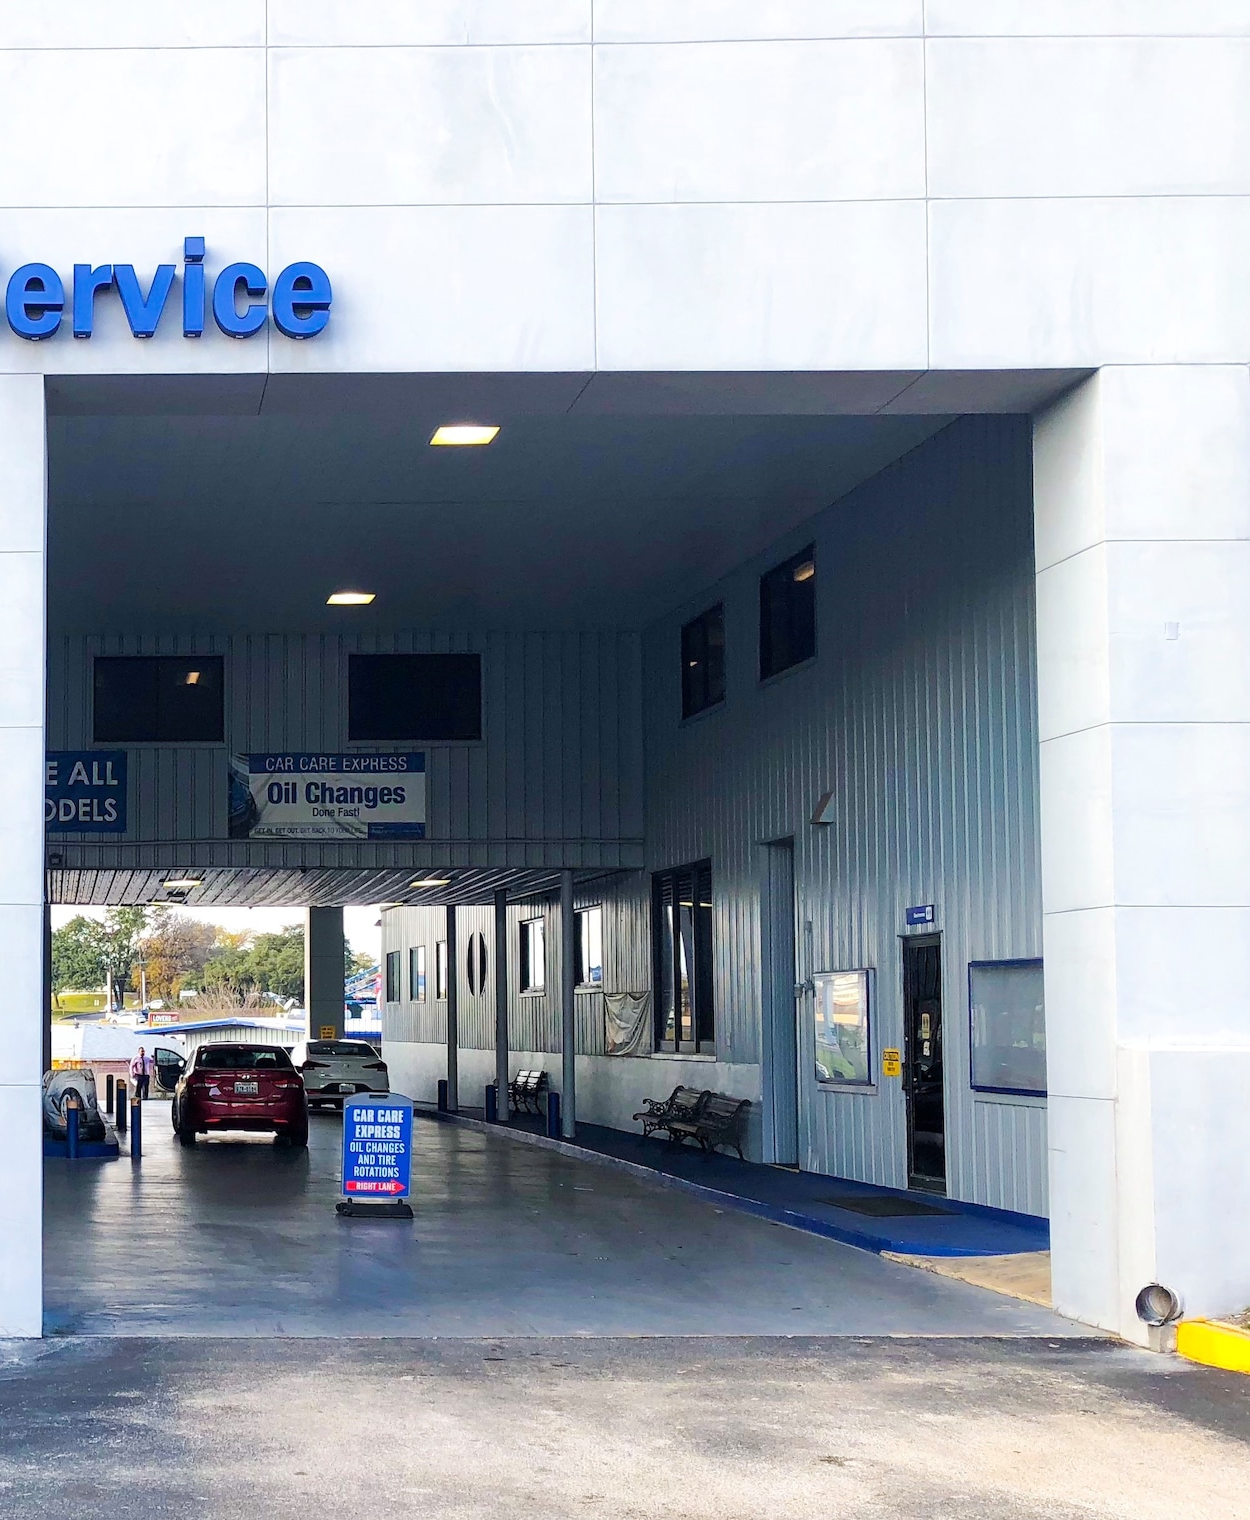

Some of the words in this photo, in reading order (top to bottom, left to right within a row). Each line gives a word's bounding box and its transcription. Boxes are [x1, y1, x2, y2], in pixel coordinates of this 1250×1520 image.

[265, 756, 294, 771] CAR
[300, 757, 337, 771] CARE
[343, 756, 408, 771] EXPRESS
[67, 761, 119, 786] ALL
[267, 781, 297, 805] Oil
[305, 781, 406, 809] Changes
[312, 807, 335, 817] Done
[338, 807, 360, 817] Fast!
[353, 1109, 374, 1123] CAR
[378, 1109, 404, 1123] CARE
[355, 1125, 401, 1139] EXPRESS
[350, 1142, 364, 1153] OIL
[366, 1142, 405, 1154] CHANGES
[358, 1154, 376, 1165] AND
[378, 1155, 396, 1165] TIRE
[354, 1166, 400, 1178] ROTATIONS
[356, 1182, 377, 1191] RIGHT
[378, 1182, 396, 1191] LANE
